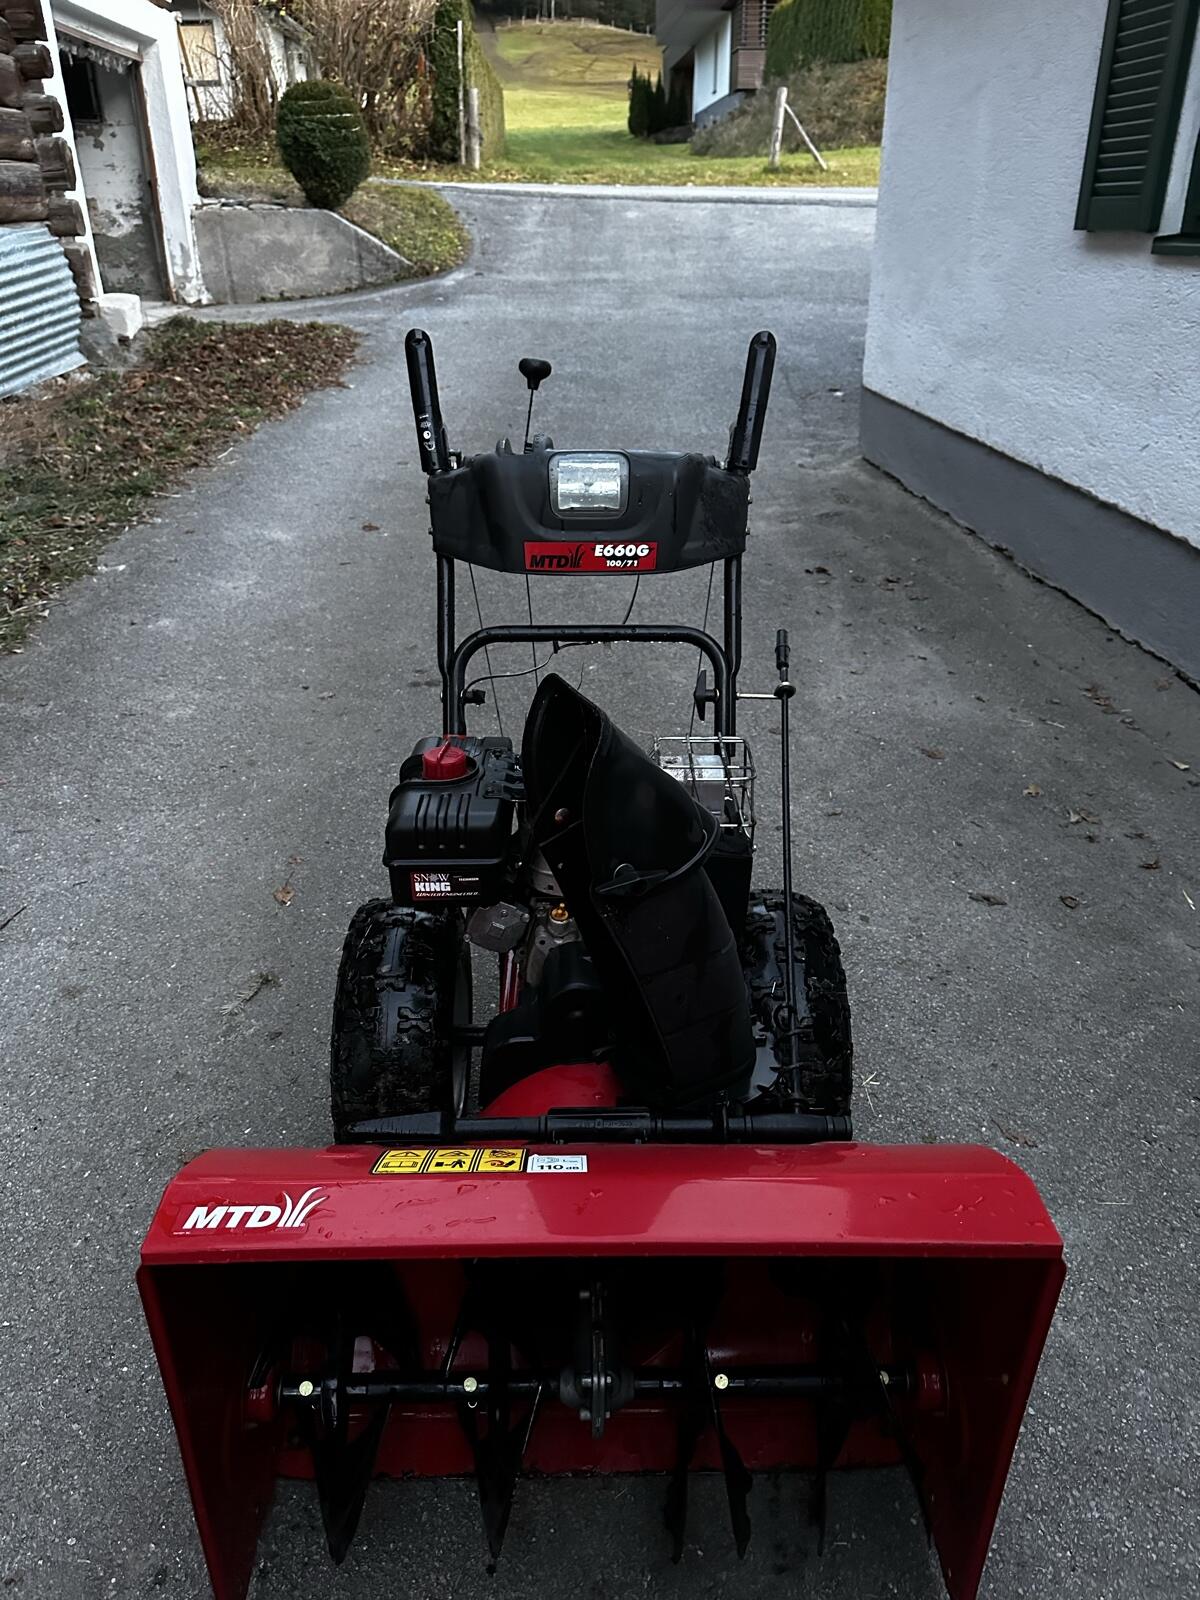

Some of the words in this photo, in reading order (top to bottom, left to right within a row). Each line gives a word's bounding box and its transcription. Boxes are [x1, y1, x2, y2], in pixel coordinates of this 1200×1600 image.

[594, 544, 650, 557] E660G
[529, 554, 570, 569] MTD
[606, 559, 638, 568] 100/71
[414, 882, 451, 892] KING
[182, 1205, 282, 1230] MTD
